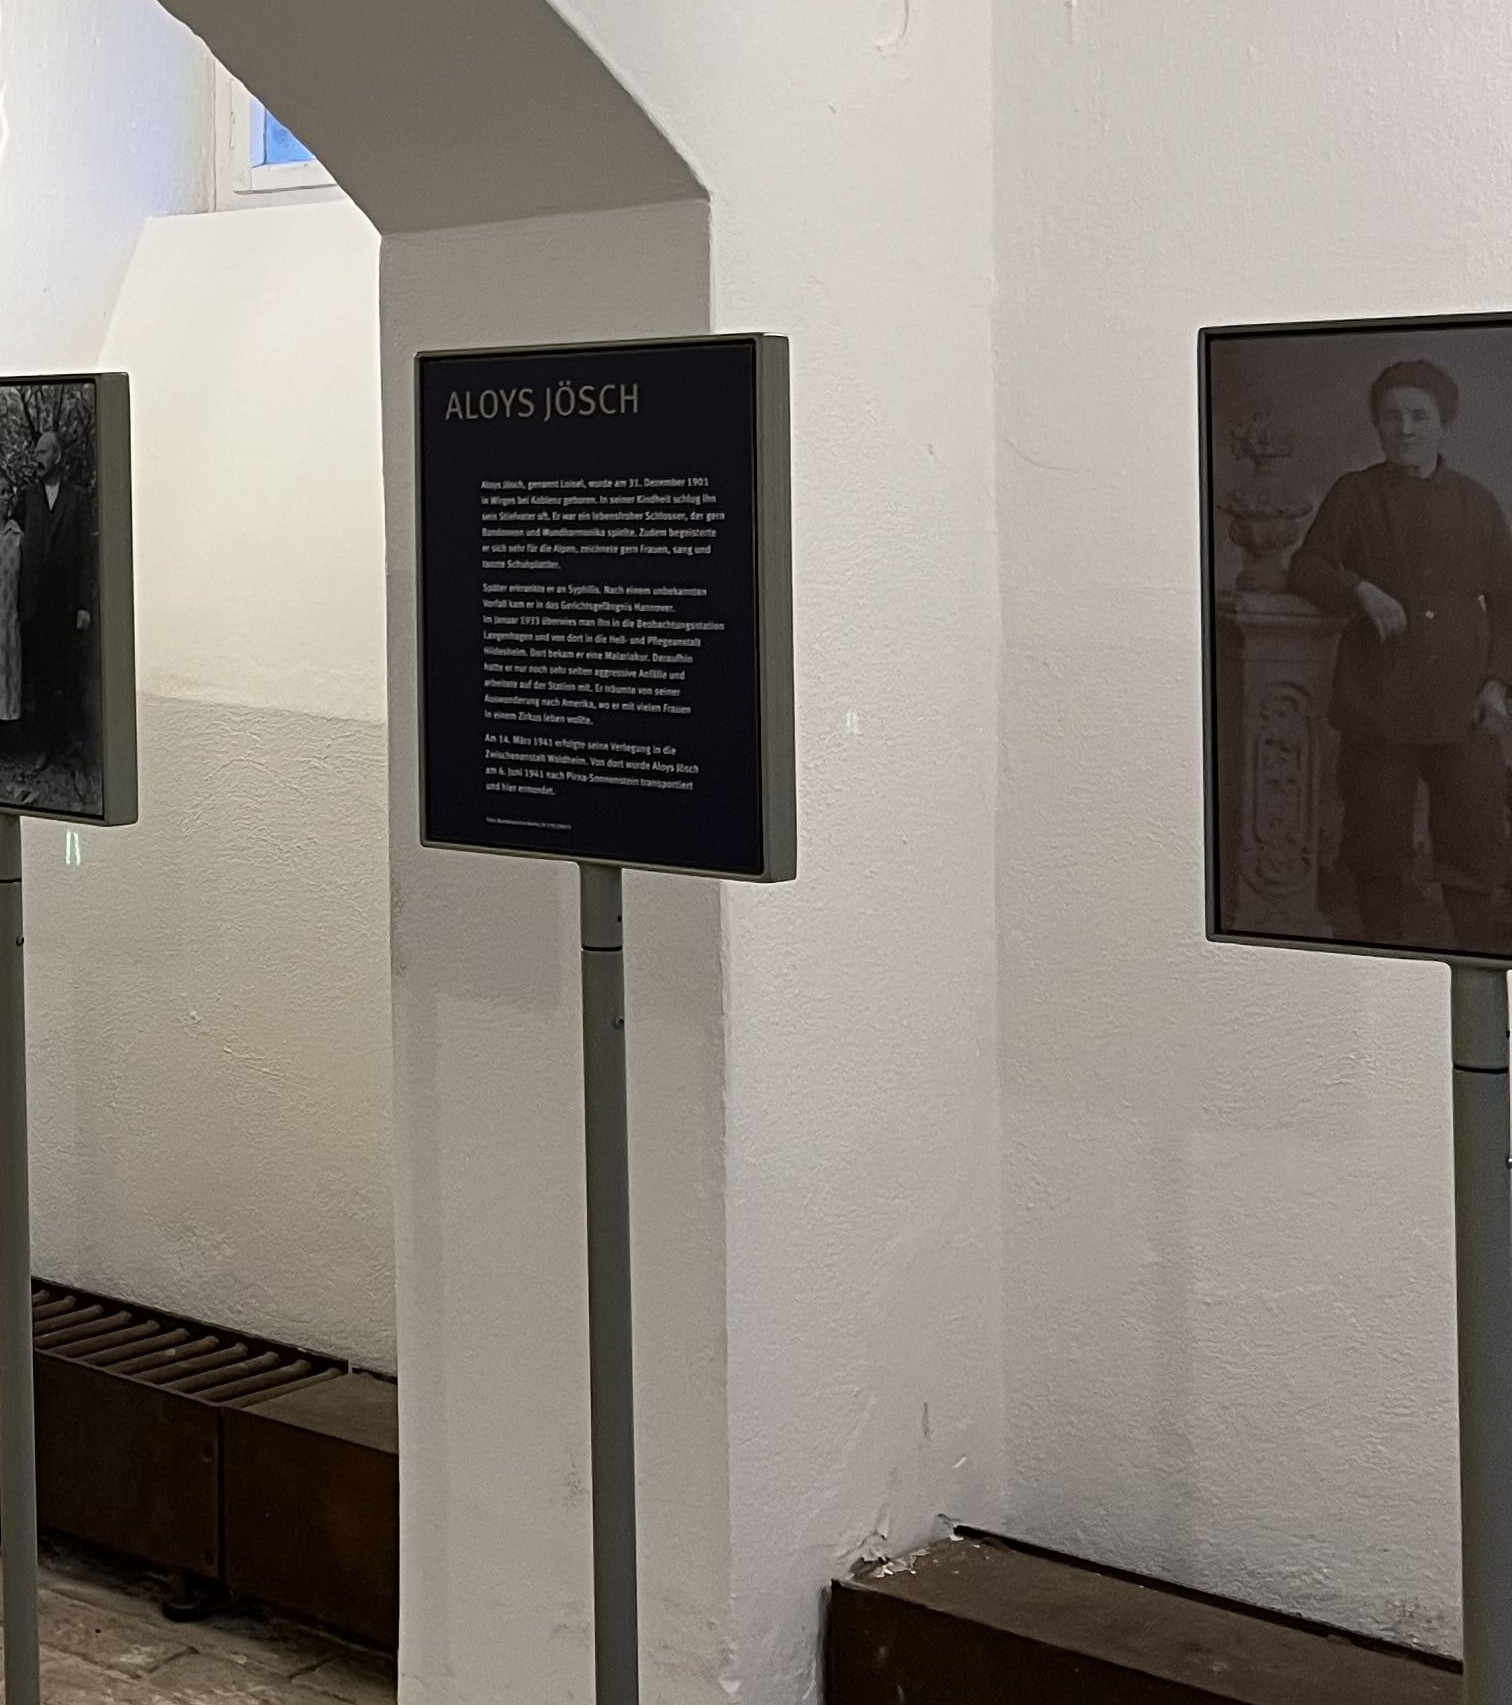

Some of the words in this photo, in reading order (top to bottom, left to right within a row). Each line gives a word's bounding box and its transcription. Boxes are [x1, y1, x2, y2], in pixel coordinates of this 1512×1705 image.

[445, 388, 535, 420] ALOYS
[544, 381, 638, 422] JÖSCH
[587, 479, 613, 488] wurde
[643, 477, 685, 487] Dezember
[687, 477, 709, 487] 1901
[525, 527, 541, 536] und
[694, 544, 711, 554] und
[560, 600, 633, 613] Gerichtsgefängnis
[636, 619, 725, 632] Beobachtungsstation
[534, 632, 550, 642] und
[566, 633, 584, 643] dort
[629, 636, 646, 645] und
[646, 635, 701, 647] Pflegeanstalt
[668, 670, 685, 680] und
[662, 703, 691, 714] Frauen
[533, 737, 553, 747] 1941
[587, 742, 609, 751] seine
[610, 742, 651, 755] Verlegung
[606, 758, 624, 768] dort
[625, 760, 651, 771] wurde
[676, 763, 699, 774] Jösch
[524, 768, 544, 779] 1941
[485, 782, 501, 791] und
